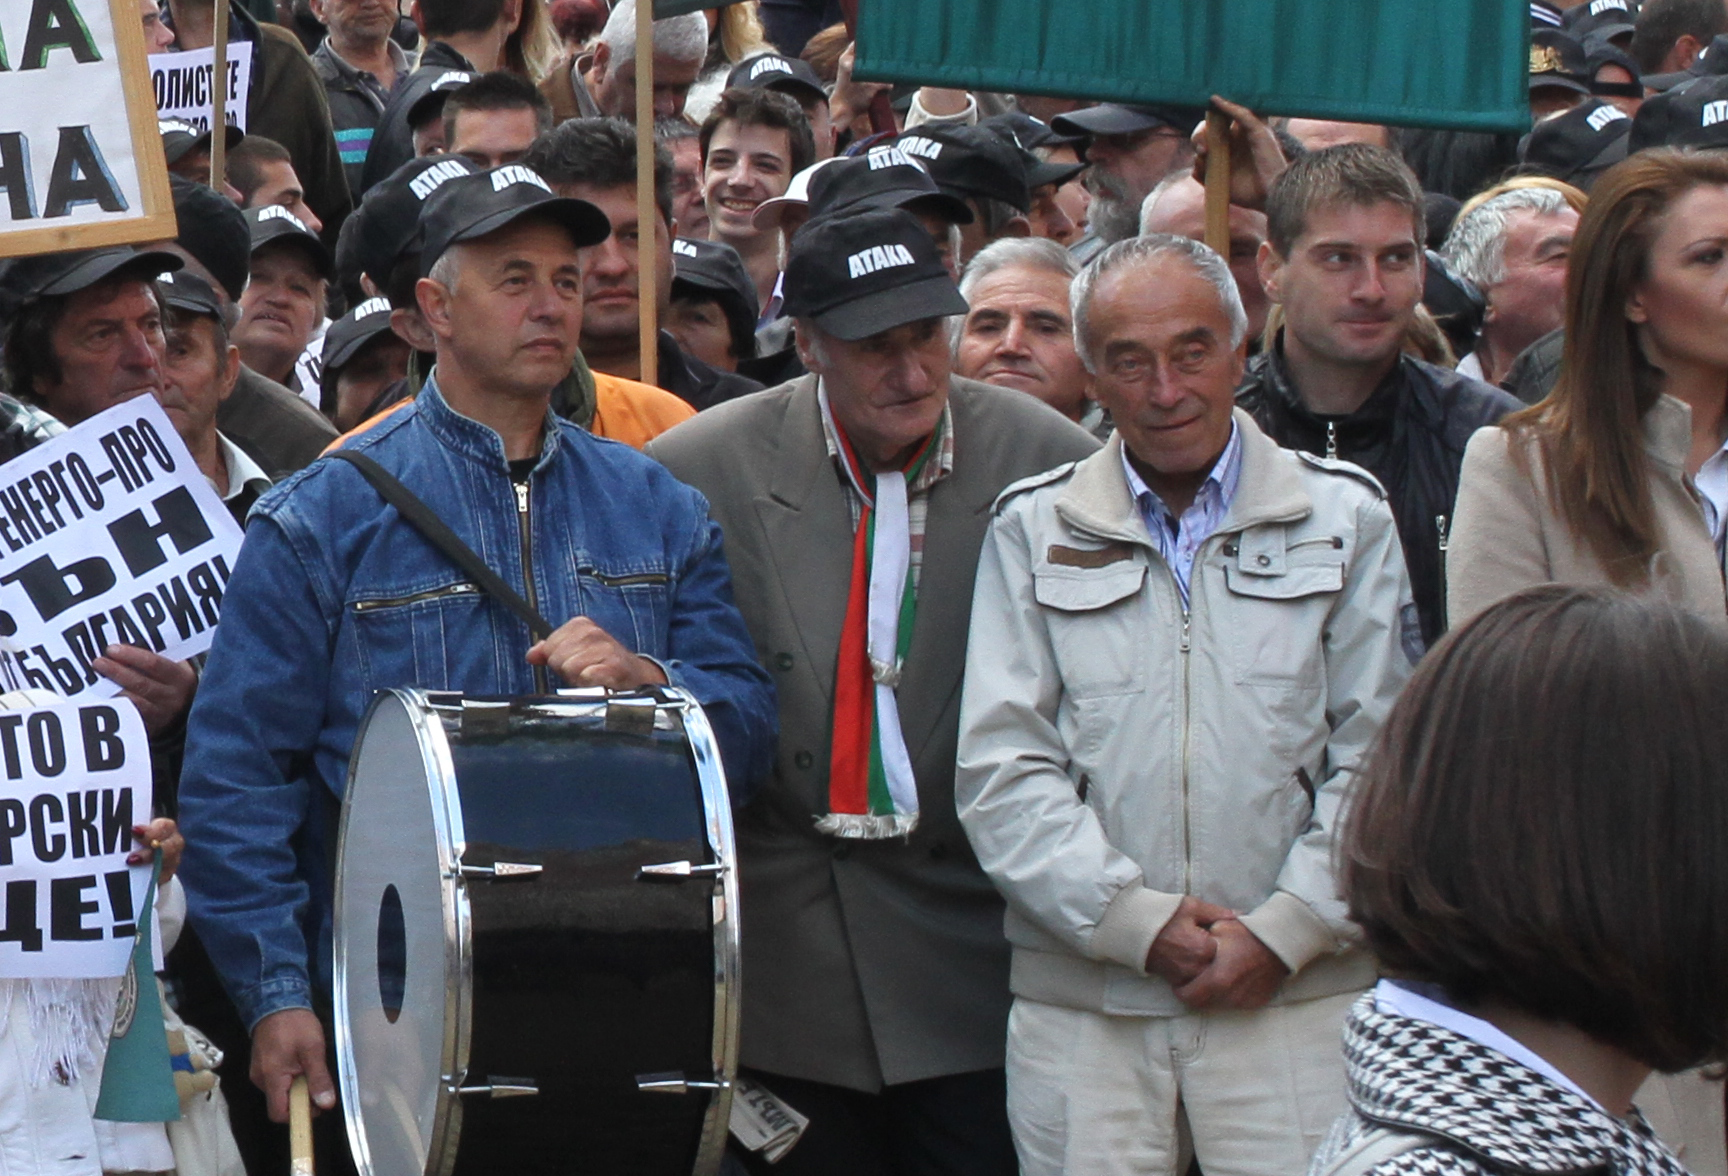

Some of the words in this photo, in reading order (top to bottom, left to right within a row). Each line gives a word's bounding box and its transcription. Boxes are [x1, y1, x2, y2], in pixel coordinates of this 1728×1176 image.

[750, 56, 793, 81] АТАКА
[848, 244, 915, 279] АТАКА
[79, 705, 126, 773] В
